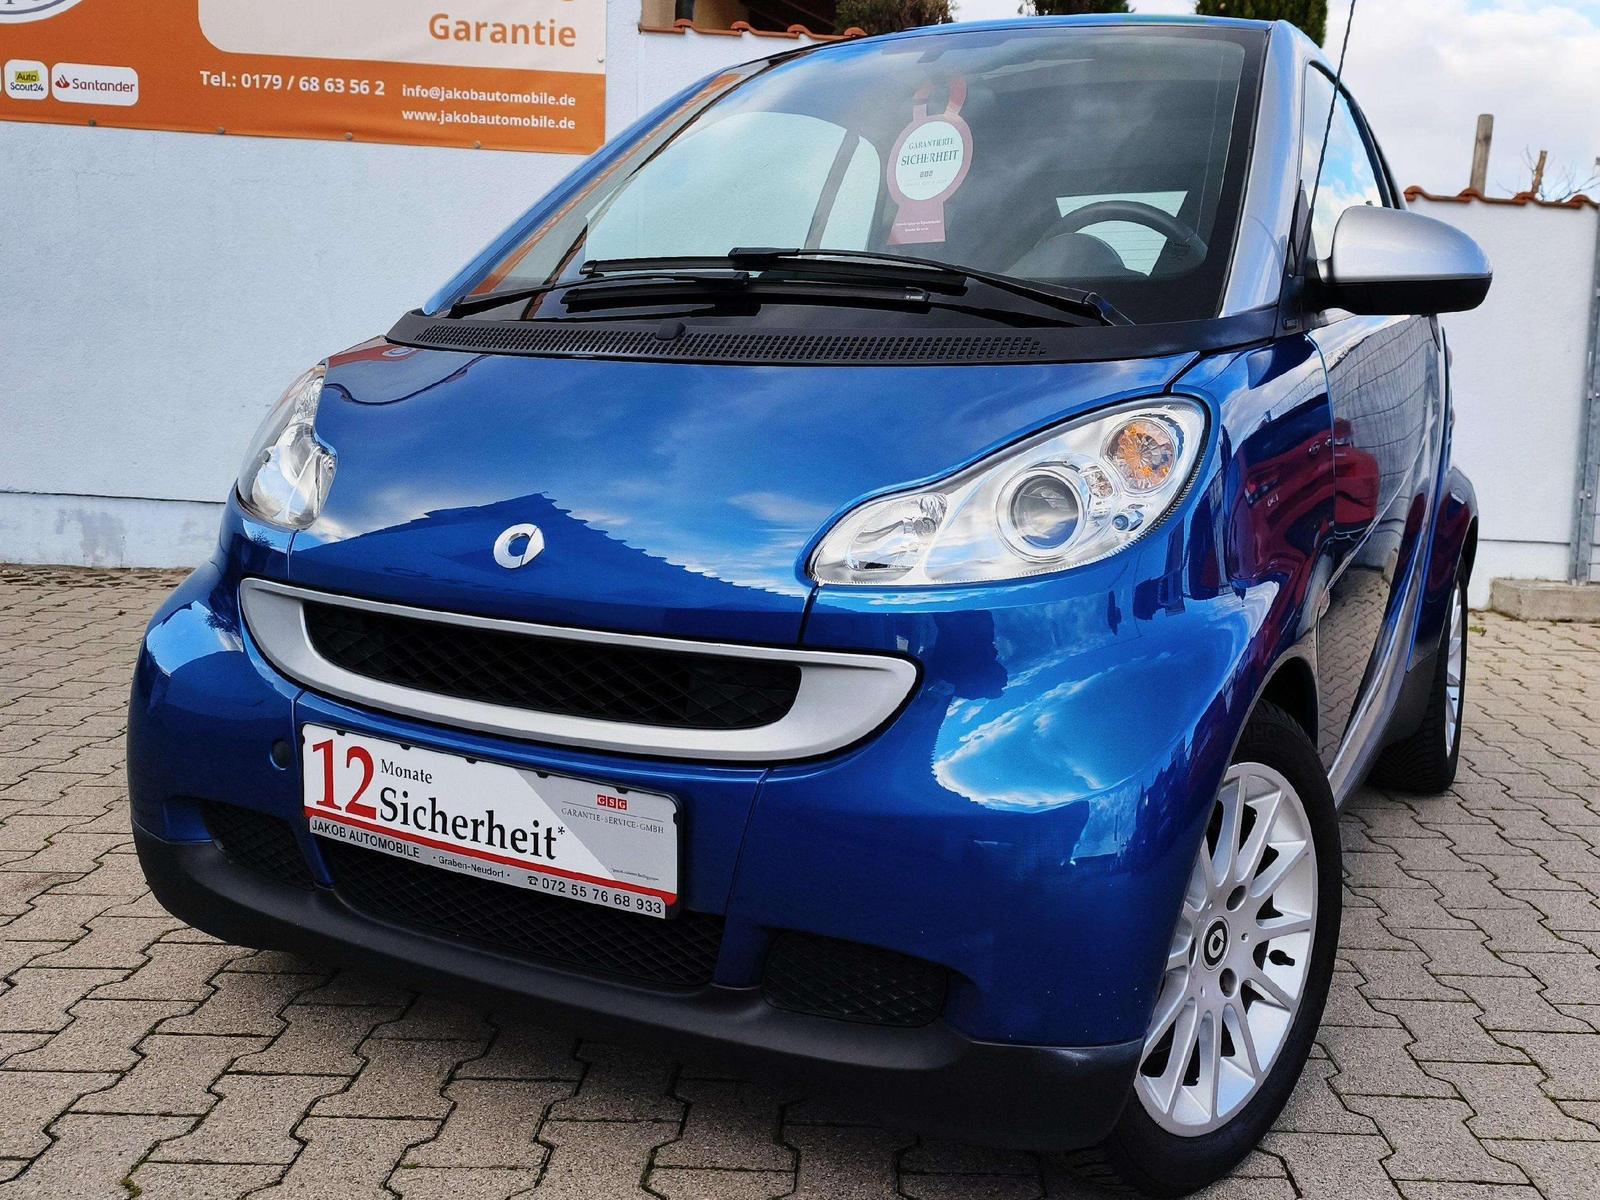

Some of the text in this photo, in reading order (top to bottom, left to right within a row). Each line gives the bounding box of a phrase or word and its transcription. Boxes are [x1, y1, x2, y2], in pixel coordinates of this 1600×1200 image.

[428, 13, 577, 47] Garantie
[10, 82, 44, 92] Scout24
[16, 72, 38, 82] Auto
[72, 78, 135, 93] Santander
[200, 70, 385, 96] Tel.: 0179 / 68 63 56 2
[402, 84, 576, 106] info@jakobautomobile.de
[402, 110, 576, 129] www.jakobautomobile.de
[901, 150, 959, 166] SICHERHEIT
[312, 739, 377, 820] 12
[380, 759, 433, 784] Monate
[597, 794, 628, 810] GSG
[312, 819, 662, 914] JAKOB AUTOMOBILE Graben-Neudorf 072 55 76 68 933
